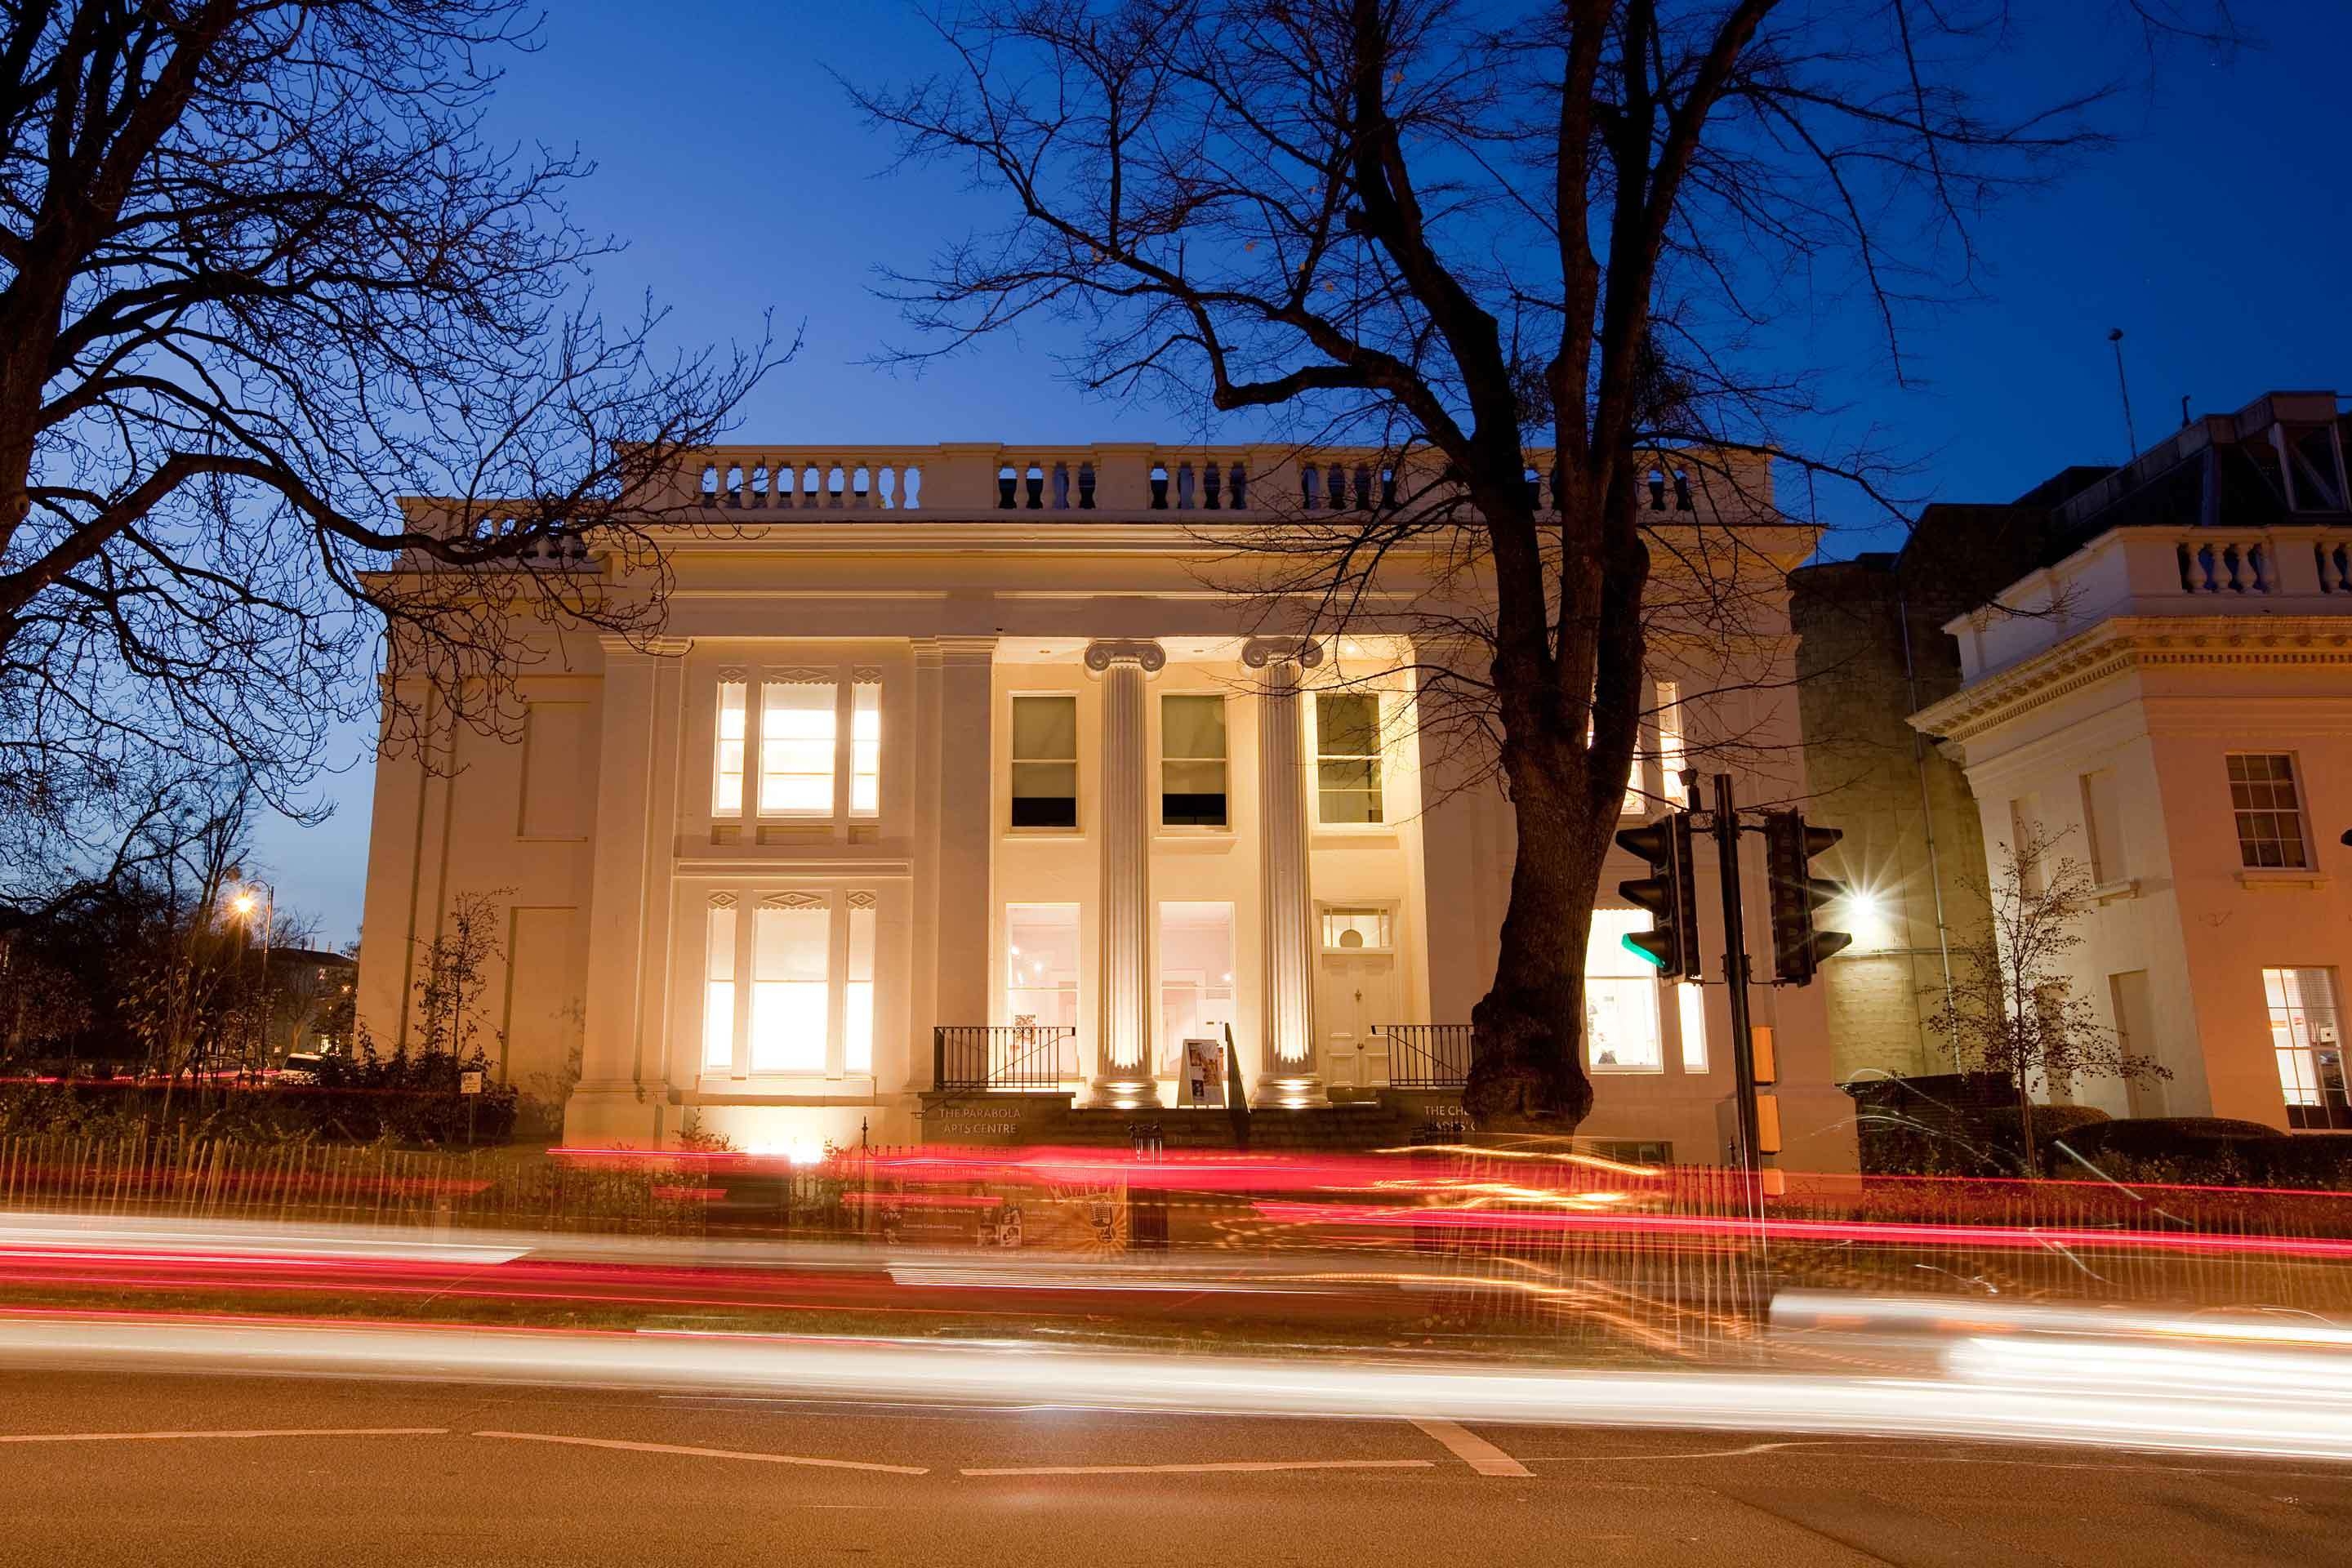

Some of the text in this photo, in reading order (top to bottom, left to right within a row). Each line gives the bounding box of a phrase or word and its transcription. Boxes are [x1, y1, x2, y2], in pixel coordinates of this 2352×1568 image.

[940, 1108, 1021, 1118] THE PARABOLA
[1424, 1106, 1445, 1116] THE
[944, 1124, 1017, 1134] ARTS CENTRE
